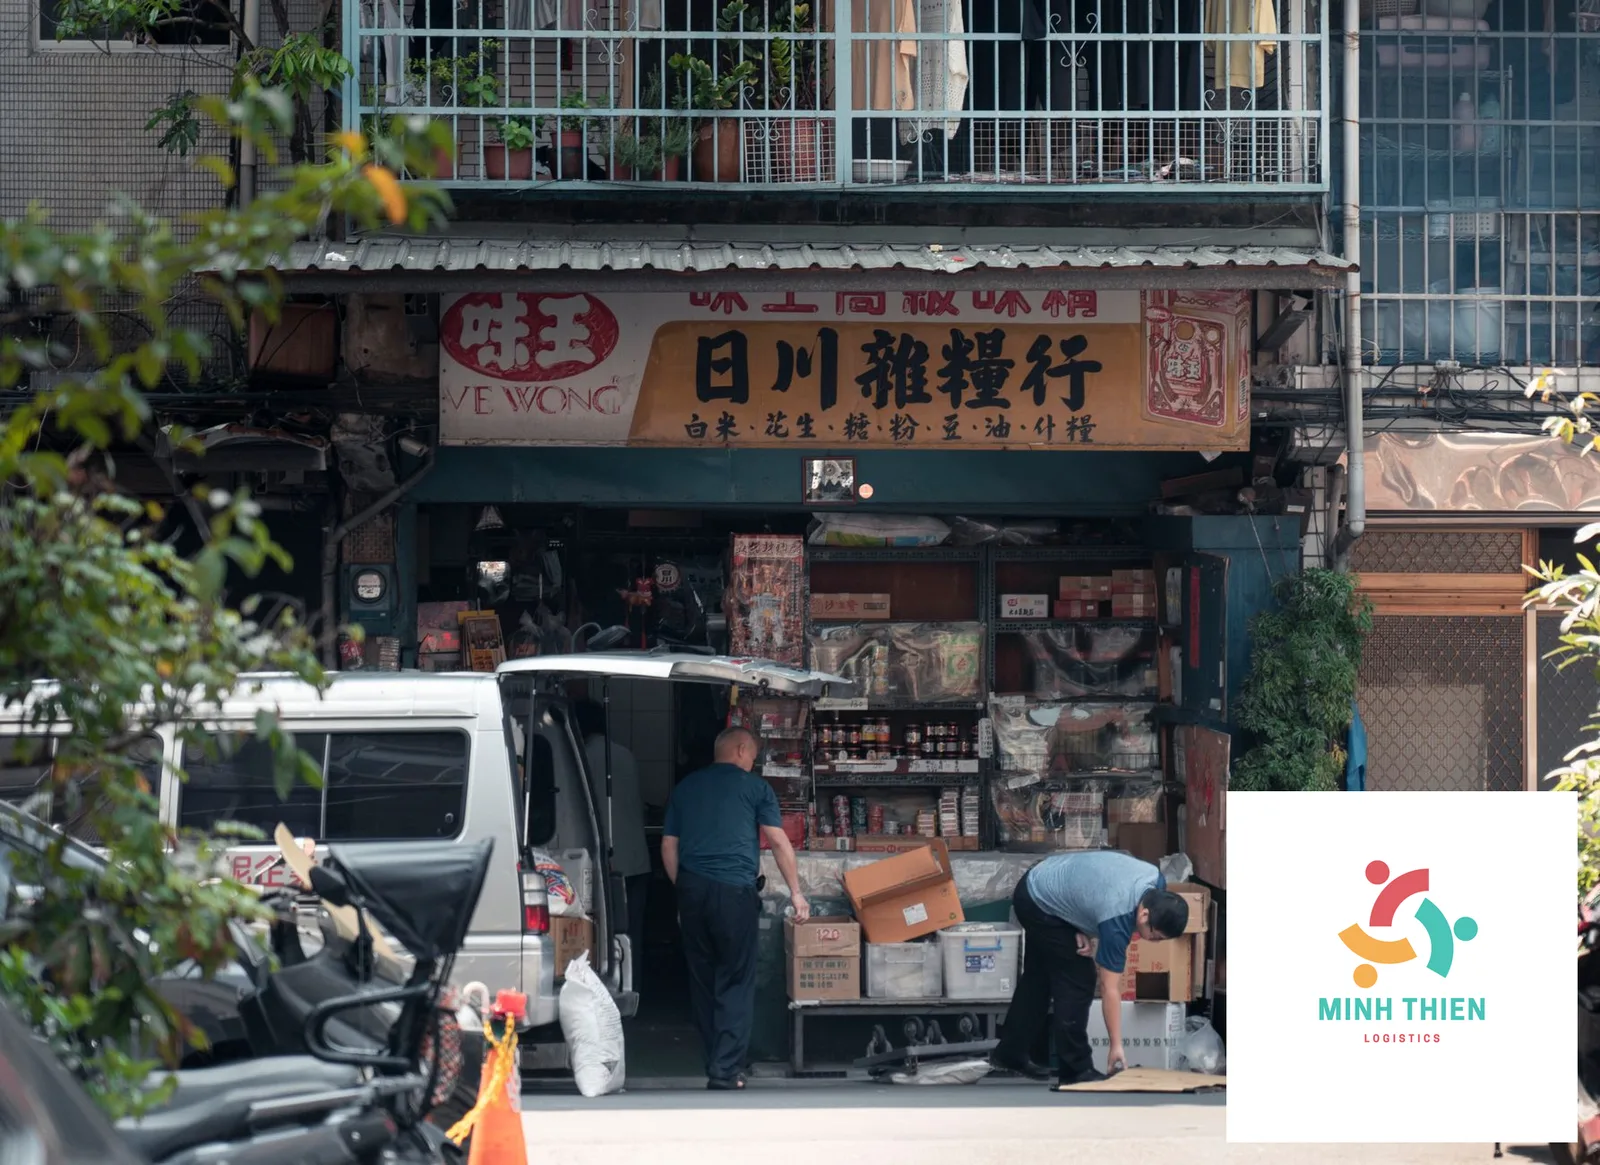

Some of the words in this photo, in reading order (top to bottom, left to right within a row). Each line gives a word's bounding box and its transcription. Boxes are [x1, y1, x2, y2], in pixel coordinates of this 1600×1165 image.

[696, 326, 1103, 412] 日川雜糧行
[445, 385, 494, 414] VE
[502, 385, 621, 415] WONG
